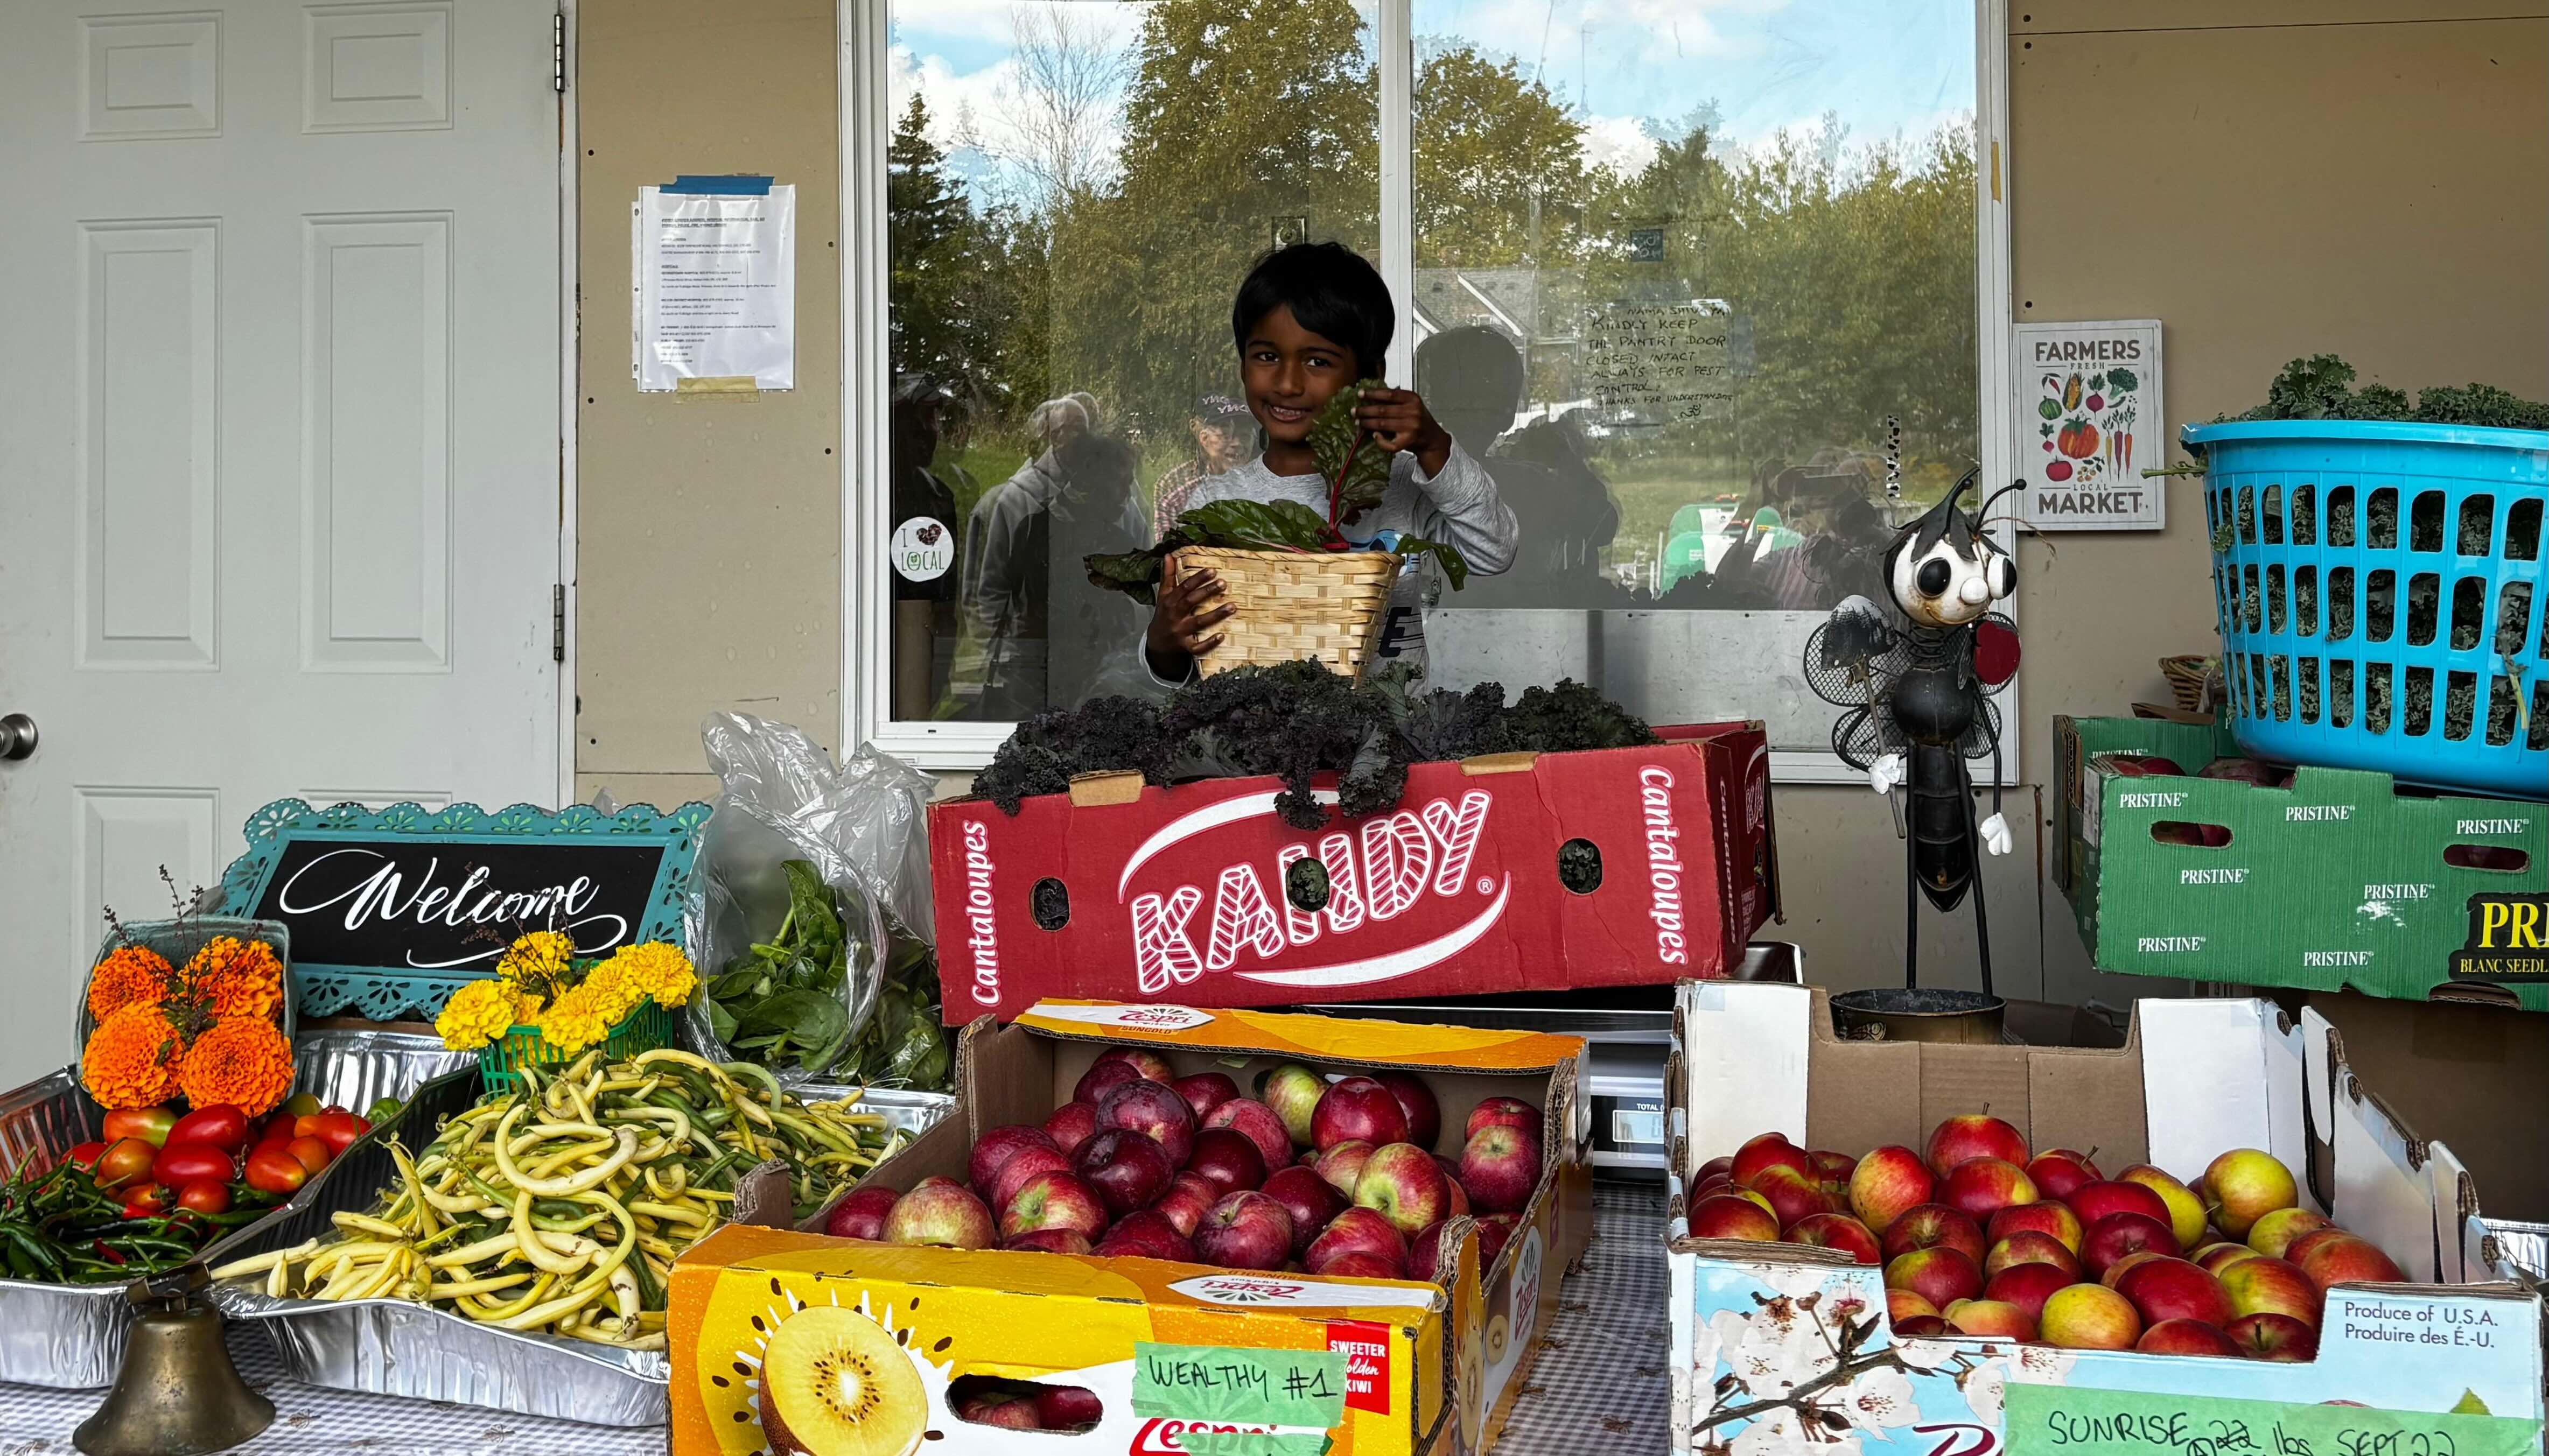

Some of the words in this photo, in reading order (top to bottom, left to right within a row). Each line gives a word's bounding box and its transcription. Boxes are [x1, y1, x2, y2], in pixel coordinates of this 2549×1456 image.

[1592, 316, 1648, 330] KINDLY
[1659, 319, 1698, 330] KEEP
[1620, 336, 1676, 347] PANTRY
[1686, 335, 1726, 347] DOOR
[2035, 340, 2141, 361] FARMERS
[1586, 354, 1638, 365] CLOSED
[1649, 352, 1697, 362] INTACT
[1591, 366, 1645, 378] ALWAYS
[1658, 367, 1685, 376] FOR
[1694, 366, 1725, 376] PEST
[1644, 396, 1661, 404] FOR
[2039, 492, 2143, 514] MARKET
[901, 528, 907, 547] I
[901, 551, 944, 571] LOCAL
[1640, 768, 1685, 965] Cantaloupes
[1720, 777, 1736, 944] Cantaloupes
[279, 849, 627, 953] Welcome
[964, 821, 999, 1005] Cantaloupes
[2460, 959, 2503, 973] BLANC
[1118, 1010, 1193, 1023] Zespri
[1637, 1103, 1658, 1111] TOTAL
[1200, 1279, 1305, 1299] Zespri
[2345, 1302, 2411, 1320] Produce
[2417, 1304, 2434, 1322] of
[2444, 1308, 2498, 1326] U.S.A.
[2345, 1323, 2415, 1342] Produire
[2420, 1327, 2448, 1345] des
[2454, 1326, 2495, 1348] É.-U.
[1330, 1340, 1385, 1357] SWEETER
[1149, 1355, 1269, 1402] WEALTHY
[1282, 1366, 1338, 1401] #1
[1345, 1379, 1371, 1394] KIWI
[2049, 1411, 2190, 1446] SUNRISE
[2337, 1429, 2406, 1456] SEPT
